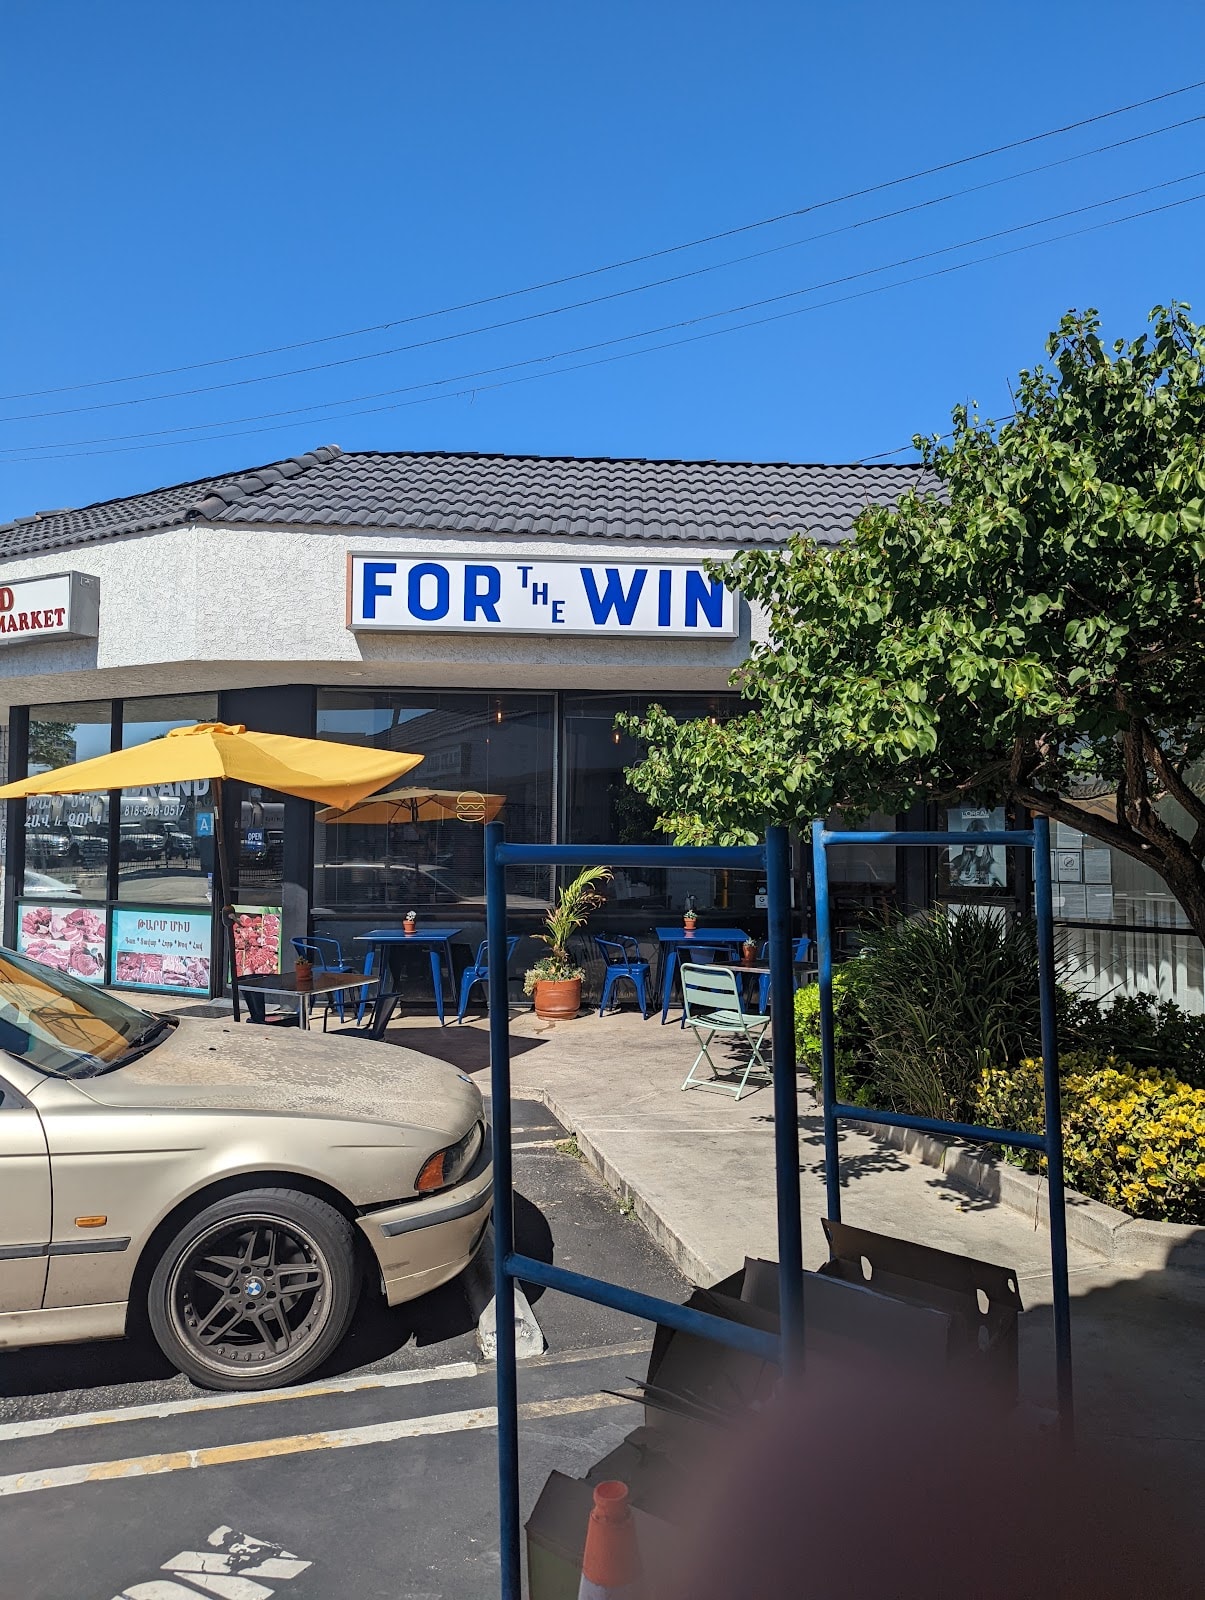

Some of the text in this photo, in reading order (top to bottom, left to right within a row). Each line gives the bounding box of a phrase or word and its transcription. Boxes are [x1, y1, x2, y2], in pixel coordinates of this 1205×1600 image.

[362, 562, 724, 628] FOR THE WIN
[199, 817, 209, 831] A
[247, 832, 263, 841] OPEN
